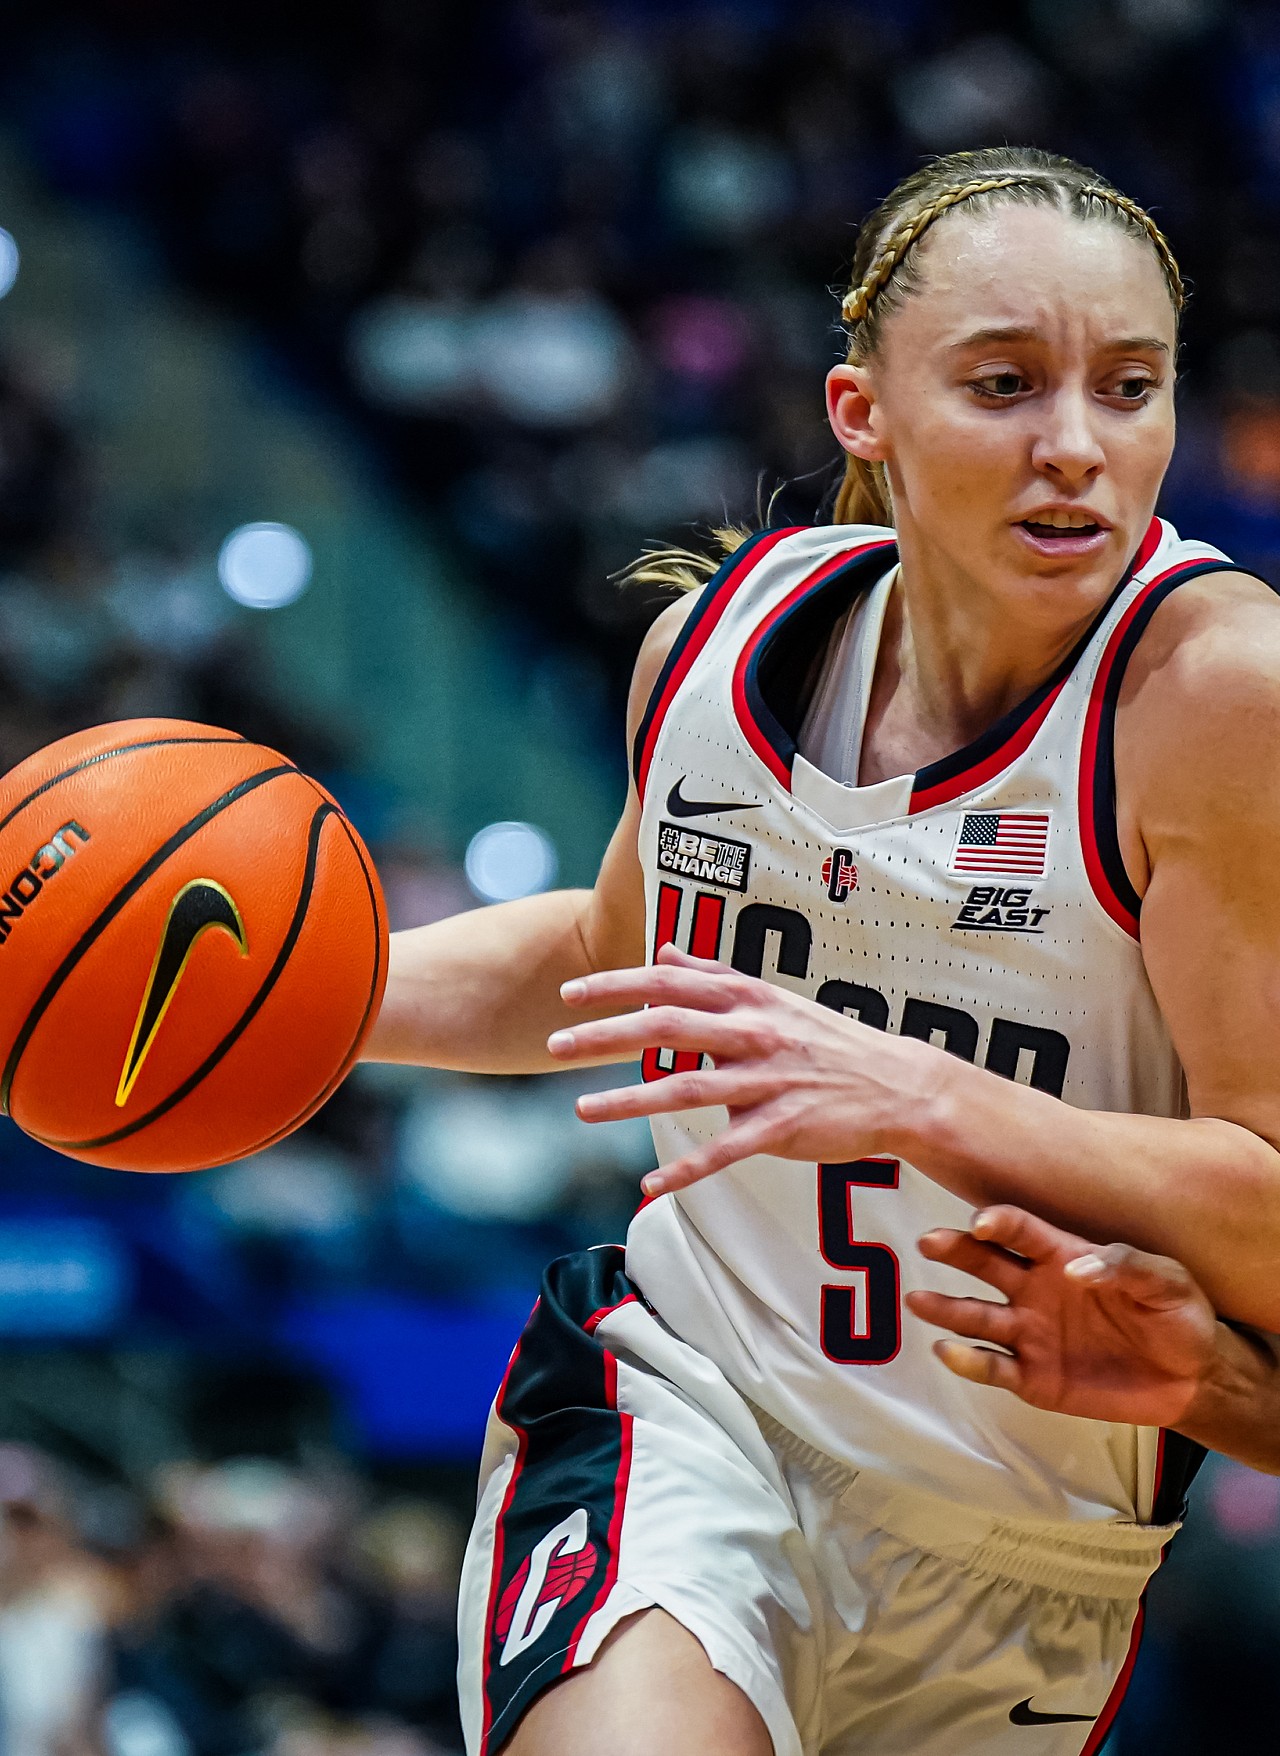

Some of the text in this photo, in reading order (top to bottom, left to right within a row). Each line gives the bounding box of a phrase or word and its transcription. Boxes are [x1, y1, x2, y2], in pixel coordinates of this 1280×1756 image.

[0, 819, 91, 945] UCON
[660, 851, 743, 886] CHANGE
[966, 886, 1033, 908] BIG
[957, 905, 1051, 927] EAST
[817, 1157, 902, 1366] 5
